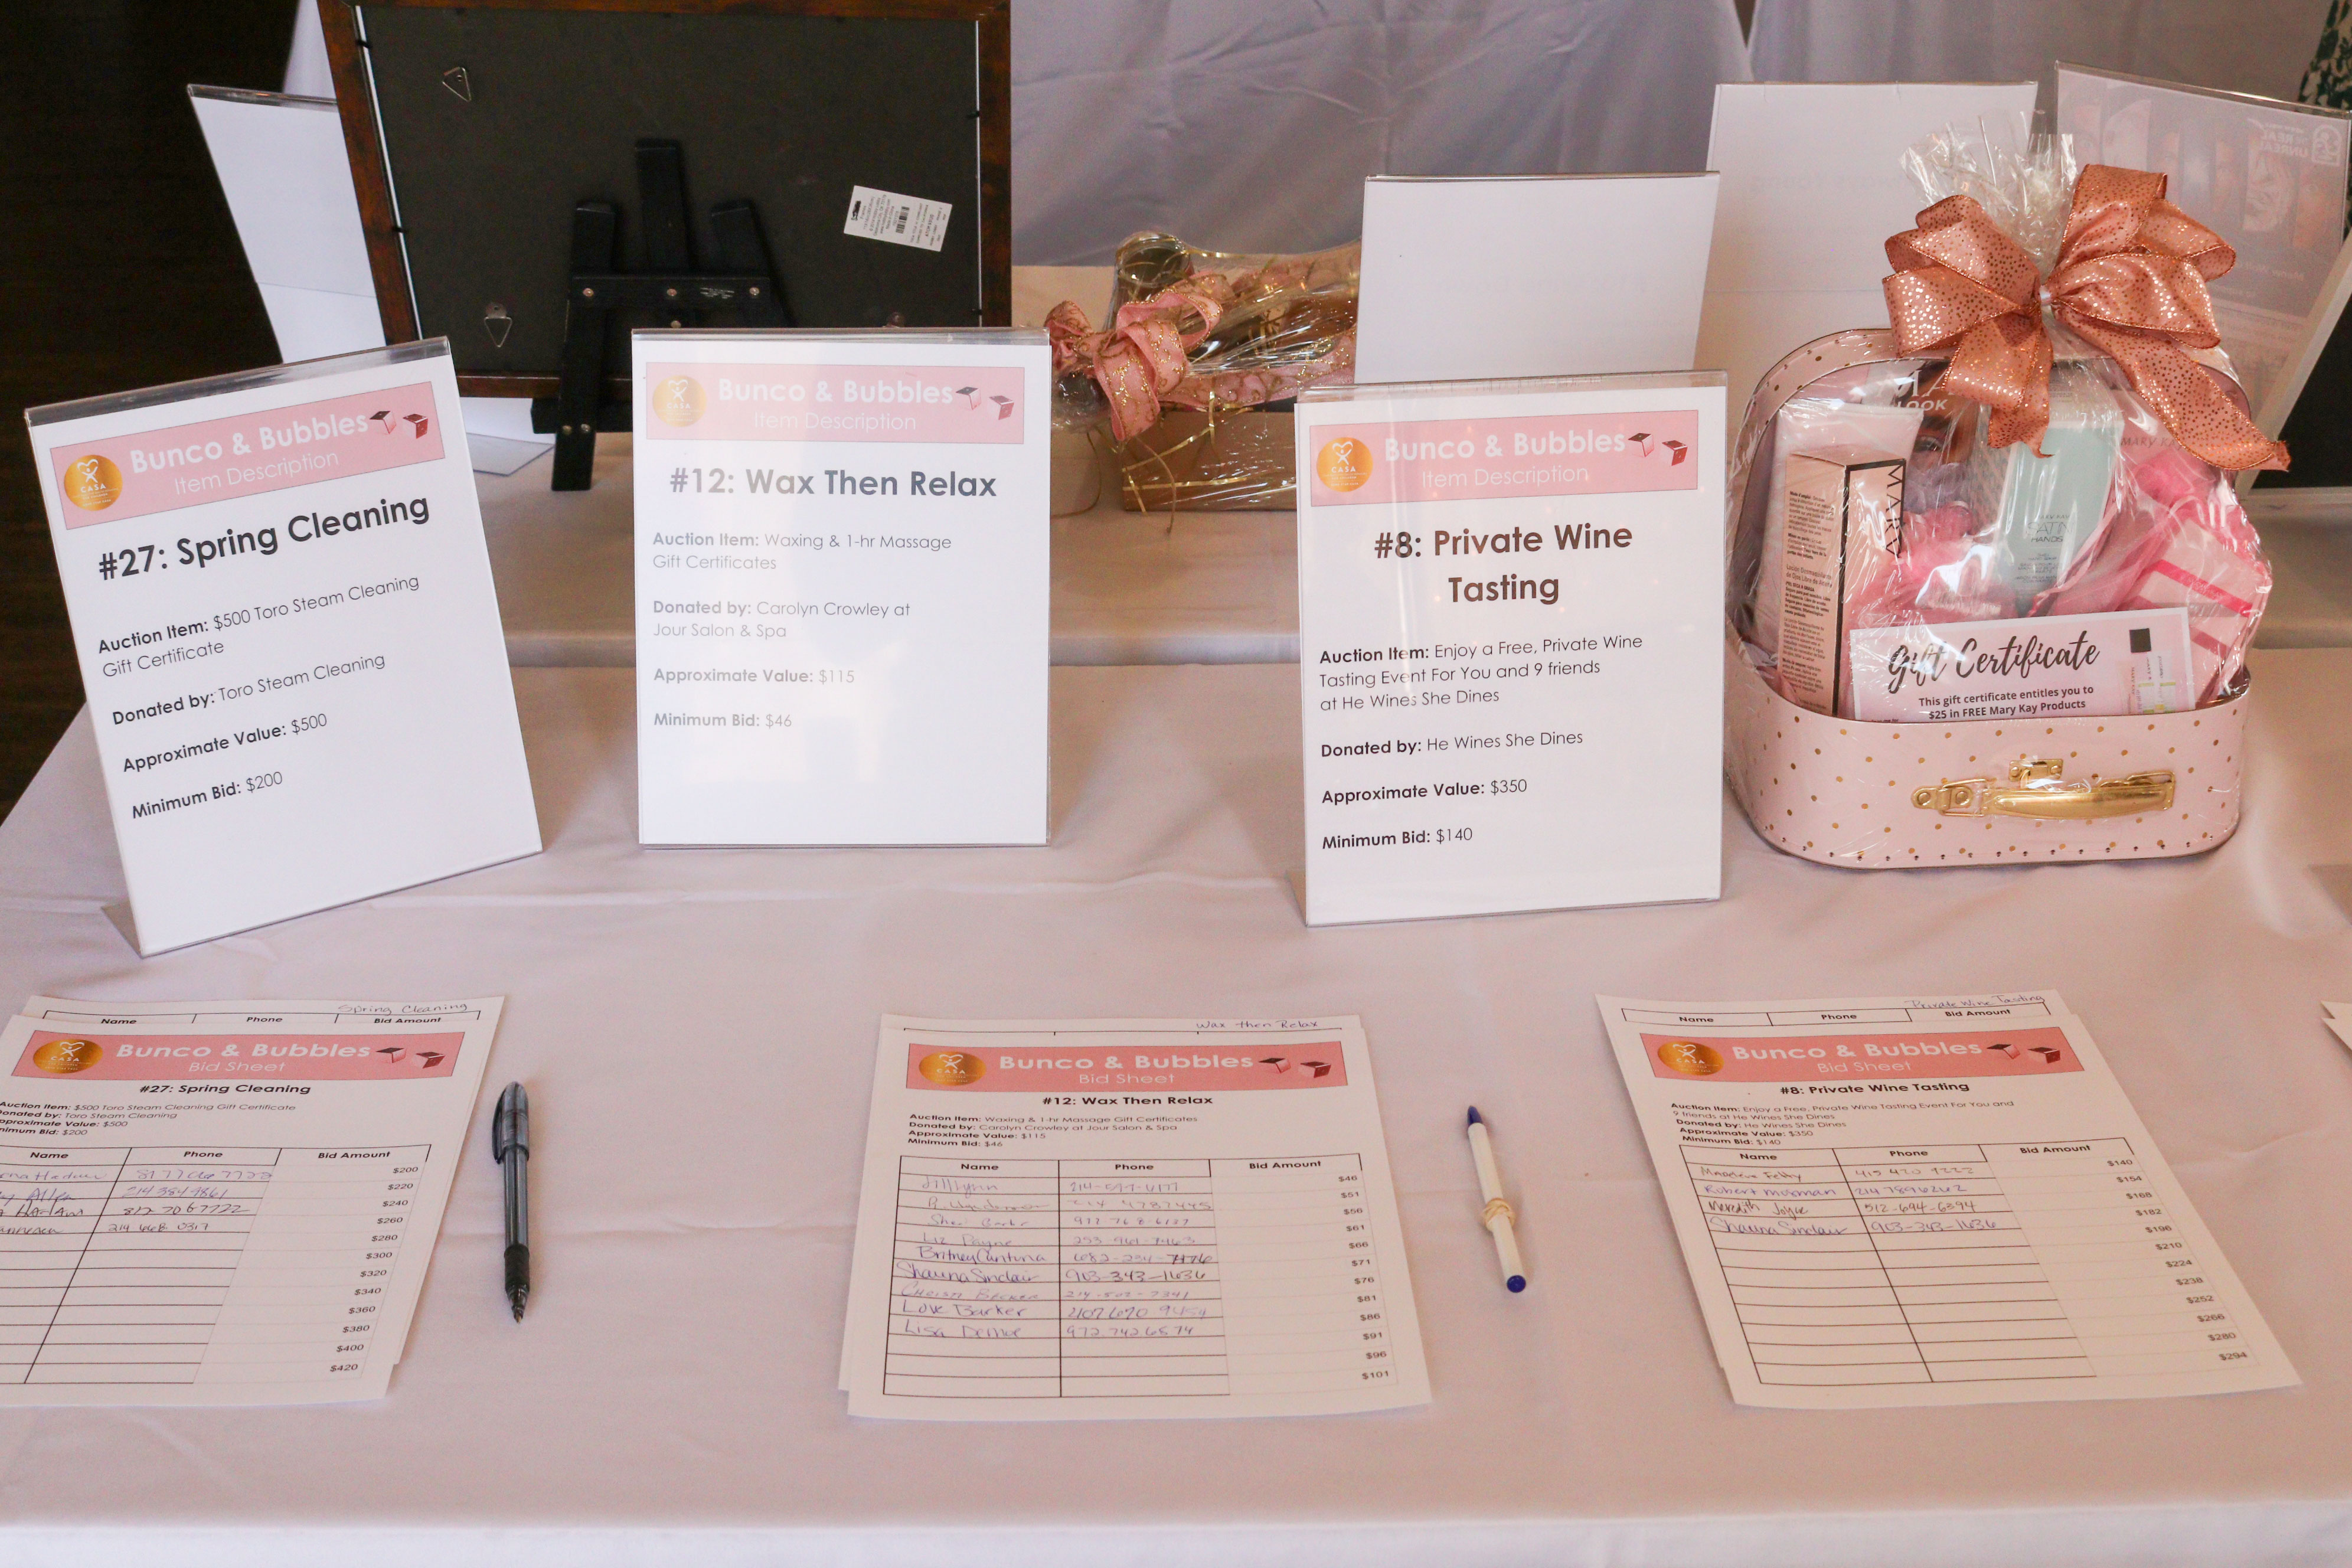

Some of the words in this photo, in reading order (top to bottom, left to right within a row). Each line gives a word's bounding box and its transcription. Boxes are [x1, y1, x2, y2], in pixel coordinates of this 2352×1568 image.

[718, 378, 806, 402] Bunco
[815, 380, 834, 402] &
[844, 380, 953, 404] Bubbles
[754, 411, 798, 428] Item
[805, 412, 916, 433] Description
[130, 441, 223, 474] Bunco
[232, 432, 252, 456] &
[259, 414, 368, 450] Bubbles
[174, 475, 221, 495] Item
[226, 453, 339, 485] Description
[669, 467, 734, 494] #12:
[745, 469, 815, 494] Wax
[824, 469, 897, 495] Then
[911, 471, 997, 496] Relax
[80, 484, 106, 492] CASA
[99, 544, 168, 581] #27:
[177, 527, 278, 569] Spring
[288, 498, 429, 542] Cleaning
[652, 532, 714, 546] Auction
[720, 533, 759, 547] Item:
[765, 533, 823, 550] Waxing
[829, 535, 840, 547] &
[848, 534, 876, 547] 1-hr
[880, 535, 952, 552] Massage
[1374, 531, 1421, 559] #8:
[1435, 526, 1543, 556] Private
[1554, 522, 1632, 550] Wine
[653, 554, 681, 568] Gift
[686, 555, 776, 570] Certificates
[1448, 573, 1559, 605] Tasting
[99, 631, 162, 654] Auction
[166, 621, 208, 639] Item:
[213, 609, 250, 632] $500
[254, 605, 289, 620] Toro
[293, 593, 344, 613] Steam
[348, 577, 419, 600] Cleaning
[654, 600, 721, 614] Donated
[727, 601, 751, 618] by:
[757, 601, 818, 618] Carolyn
[824, 602, 889, 619] Crowley
[894, 603, 910, 616] at
[653, 623, 687, 636] Jour
[691, 623, 734, 636] Salon
[740, 624, 751, 637] &
[756, 623, 786, 641] Spa
[103, 659, 132, 677] Gift
[137, 642, 224, 669] Certificate
[1889, 640, 1947, 694] Gift
[1956, 631, 2100, 678] Certificate
[1319, 672, 1376, 688] Tasting
[1381, 668, 1426, 684] Event
[1432, 668, 1455, 682] For
[1461, 667, 1491, 681] You
[1496, 663, 1528, 678] and
[1534, 662, 1543, 676] 9
[1548, 659, 1600, 676] friends
[112, 697, 185, 725] Donated
[188, 693, 215, 708] by:
[218, 685, 253, 701] Toro
[257, 672, 309, 692] Steam
[313, 656, 385, 680] Cleaning
[1320, 697, 1337, 711] at
[1343, 696, 1364, 710] He
[1370, 694, 1417, 707] Wines
[1422, 691, 1451, 705] She
[1457, 690, 1499, 703] Dines
[1918, 697, 1941, 707] This
[1943, 695, 1961, 707] gift
[1964, 692, 2017, 703] certificate
[2020, 688, 2059, 699] entitles
[2061, 688, 2080, 698] you
[2083, 686, 2093, 694] to
[1928, 710, 1947, 720] $25
[1950, 709, 1959, 718] in
[1962, 707, 1987, 717] FREE
[1990, 706, 2016, 716] Mary
[2019, 704, 2037, 714] Kay
[2040, 700, 2086, 711] Products
[123, 737, 230, 772] Approximate
[233, 726, 286, 745] Value:
[291, 713, 327, 735] $500
[1321, 740, 1391, 757] Donated
[1397, 740, 1421, 755] by:
[1427, 737, 1448, 751] He
[1454, 736, 1501, 749] Wines
[1505, 733, 1534, 747] She
[1541, 731, 1583, 745] Dines
[132, 792, 207, 819] Minimum
[211, 782, 241, 799] Bid:
[246, 771, 283, 793] $200
[1322, 785, 1428, 806] Approximate
[1433, 782, 1484, 796] Value:
[1491, 779, 1527, 796] $350
[338, 1004, 392, 1015] Spring
[402, 1004, 468, 1014] Cleaning
[1905, 1000, 1957, 1009] Private
[1960, 999, 1992, 1008] Wine
[1995, 995, 2045, 1004] Tasting
[999, 1056, 1094, 1069] Bunco
[1105, 1056, 1123, 1069] &
[1135, 1055, 1253, 1069] Bubbles
[178, 1084, 230, 1093] Spring
[236, 1084, 311, 1095] Cleaning
[1780, 1086, 1804, 1095] #8:
[1809, 1085, 1864, 1094] Private
[1868, 1083, 1908, 1092] Wine
[1913, 1082, 1969, 1092] Tasting
[1676, 1119, 1721, 1127] Donated
[909, 1131, 979, 1139] Approximate
[337, 1344, 364, 1353] $400
[2219, 1352, 2247, 1360] $294
[1362, 1371, 1389, 1379] $101
